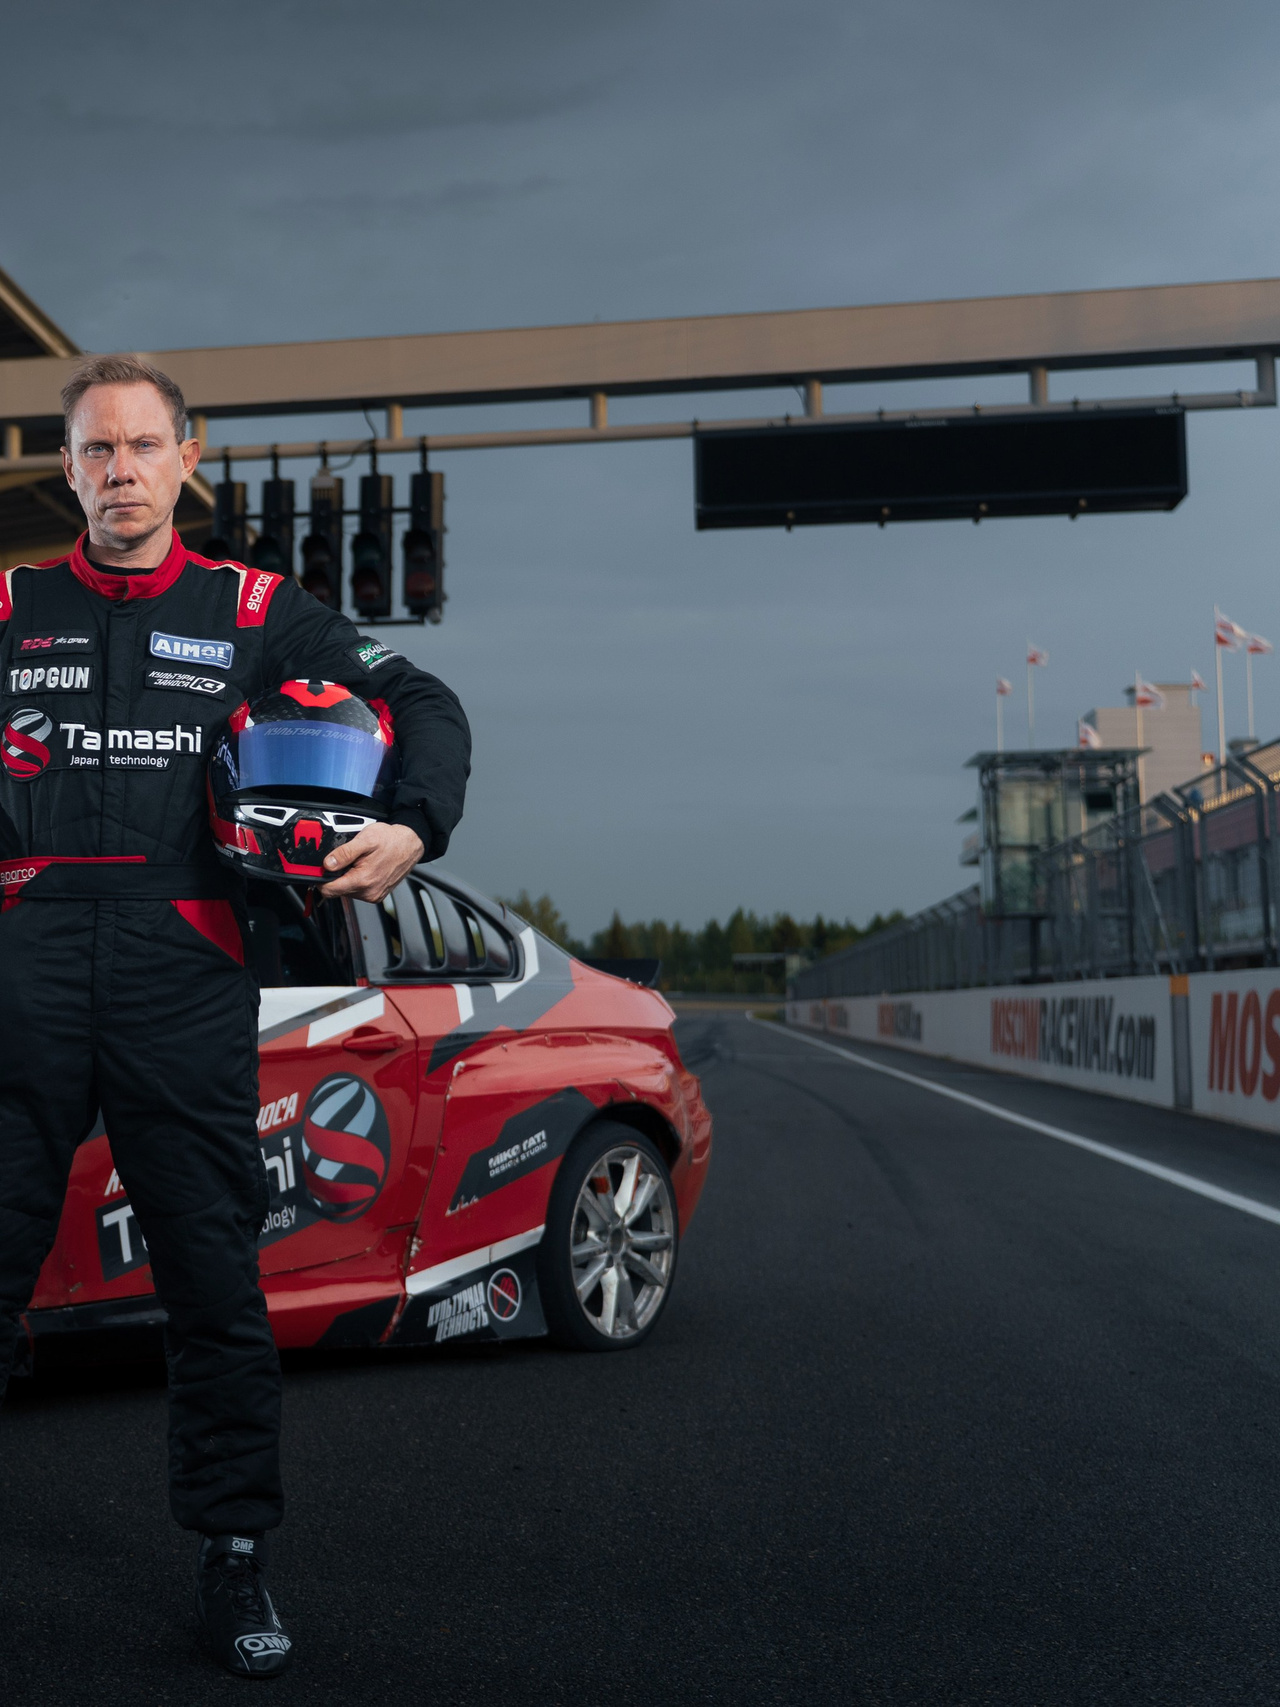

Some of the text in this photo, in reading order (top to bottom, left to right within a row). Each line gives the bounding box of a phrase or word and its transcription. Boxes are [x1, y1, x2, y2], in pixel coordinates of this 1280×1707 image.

[246, 574, 272, 611] sparco
[10, 666, 90, 692] TOPGUN
[148, 670, 196, 682] КУЛЬТУРА
[153, 678, 191, 688] ЗАНОСА
[60, 722, 202, 753] Tamashi
[264, 727, 320, 737] КУЛЬТУРА
[70, 754, 170, 768] Japan technology
[0, 867, 37, 885] sparco
[520, 1141, 548, 1161] STUDIO
[232, 1540, 254, 1551] OMP
